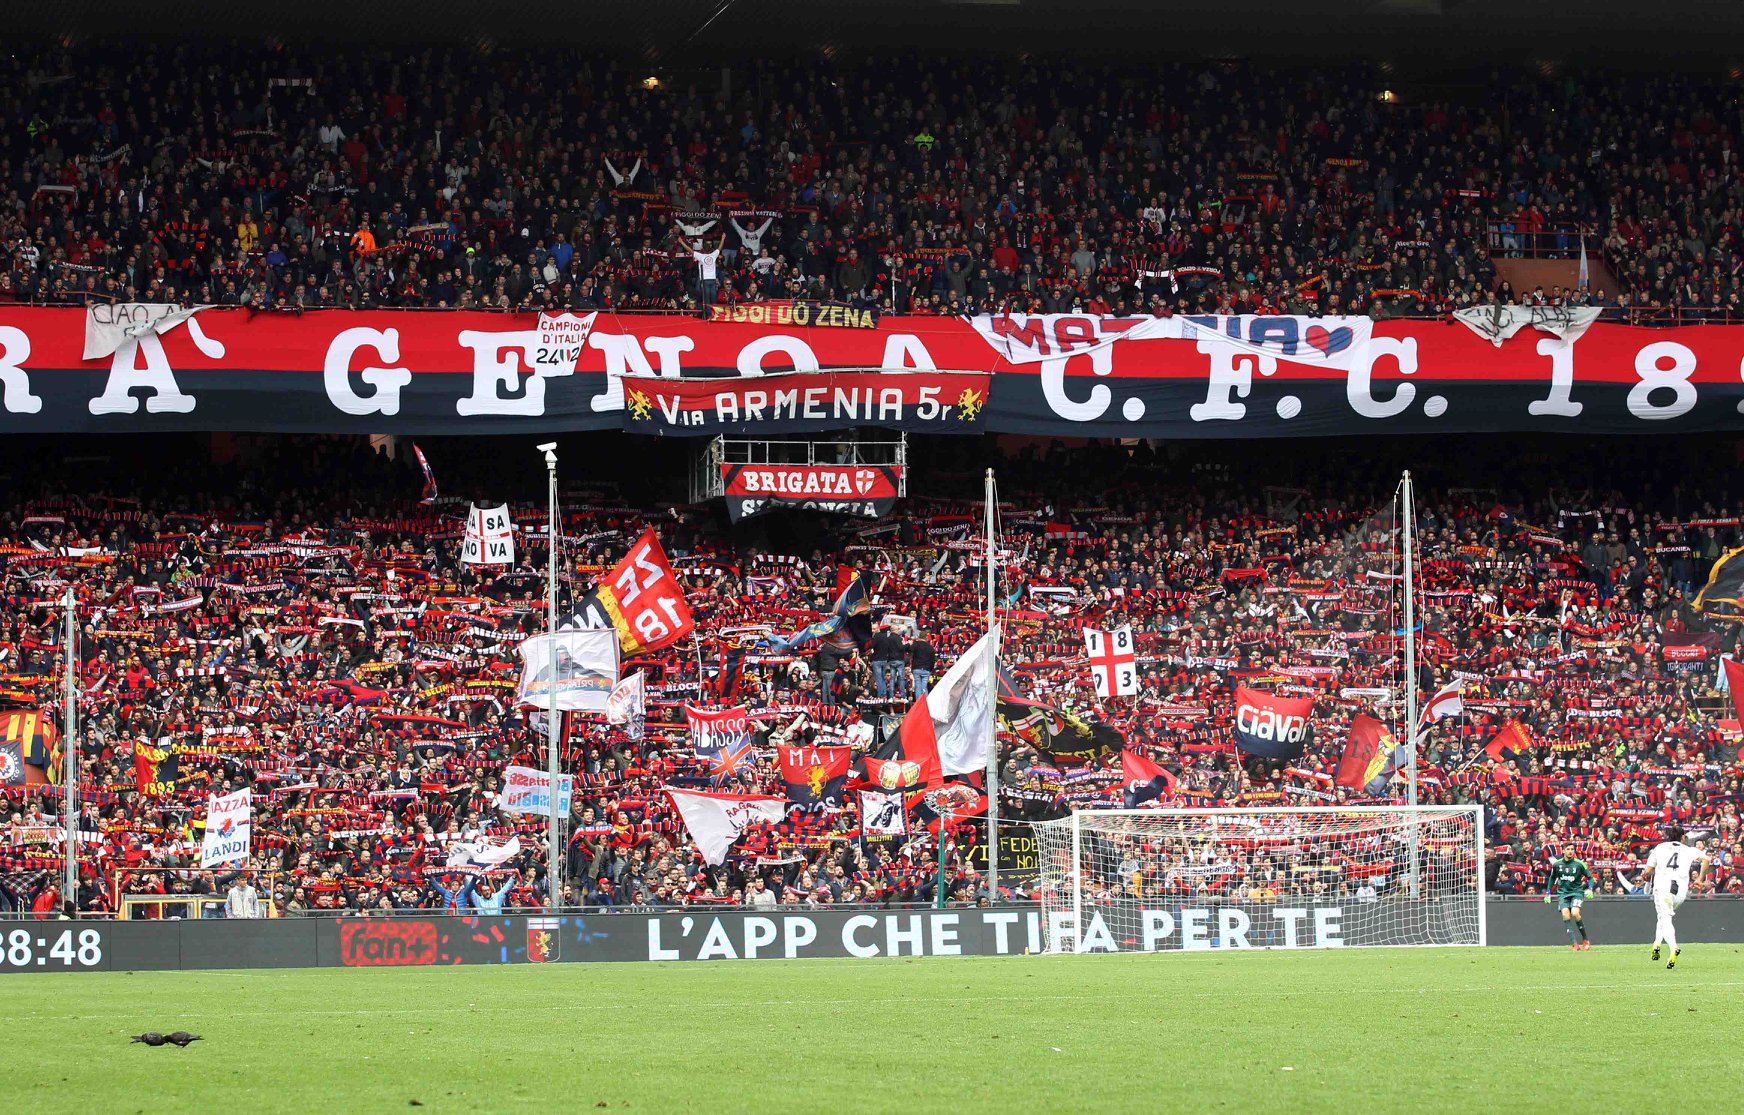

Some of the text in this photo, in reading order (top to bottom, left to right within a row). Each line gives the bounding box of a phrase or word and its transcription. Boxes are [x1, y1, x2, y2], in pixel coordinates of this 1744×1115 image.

[815, 304, 874, 328] ZENA
[541, 321, 591, 331] CAMPIONI
[543, 333, 587, 344] D'ITALIA
[1528, 339, 1744, 421] 18
[715, 387, 903, 422] ARMENIA
[743, 471, 853, 495] BRIGATA
[1452, 669, 1484, 681] GENOA
[666, 682, 699, 692] BLOCK
[1590, 708, 1623, 718] BLOCK
[789, 750, 835, 766] MAI
[143, 780, 176, 796] 1893
[210, 796, 249, 813] IAZZA
[203, 840, 247, 861] LANDI
[1666, 852, 1680, 871] 4
[1560, 874, 1575, 882] Jeep
[350, 923, 431, 961] fan+
[649, 907, 1344, 961] L'APP CHE TIFA PER TE
